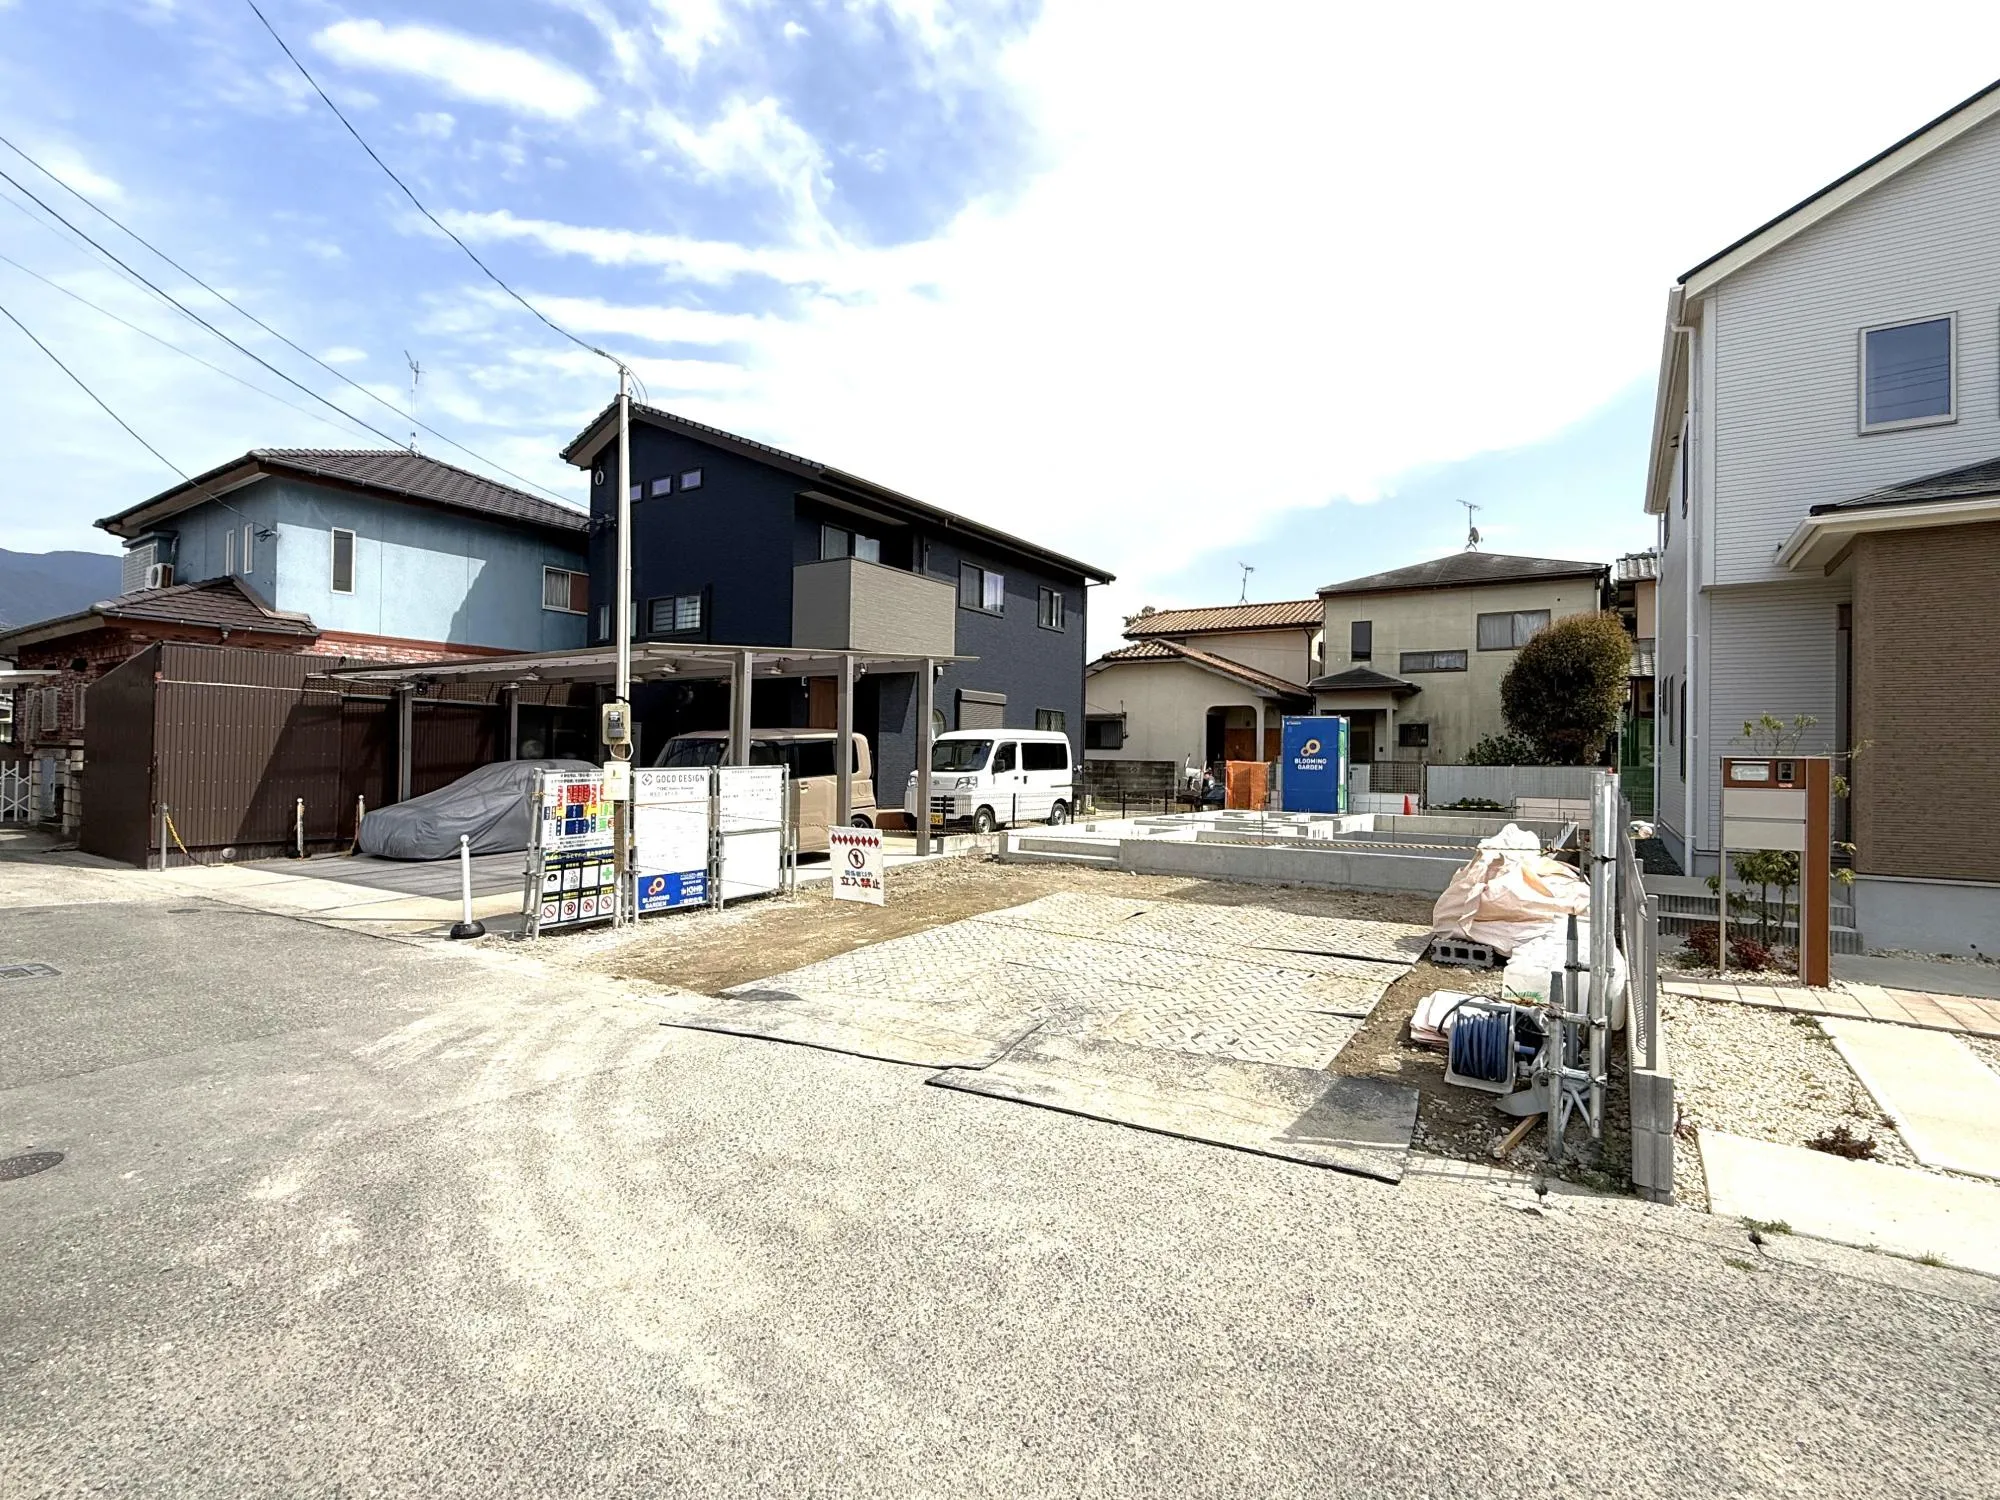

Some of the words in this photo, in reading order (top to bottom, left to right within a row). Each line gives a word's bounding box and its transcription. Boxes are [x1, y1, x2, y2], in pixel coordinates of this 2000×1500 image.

[679, 774, 704, 782] DESIGN
[840, 876, 880, 889] 立入禁止
